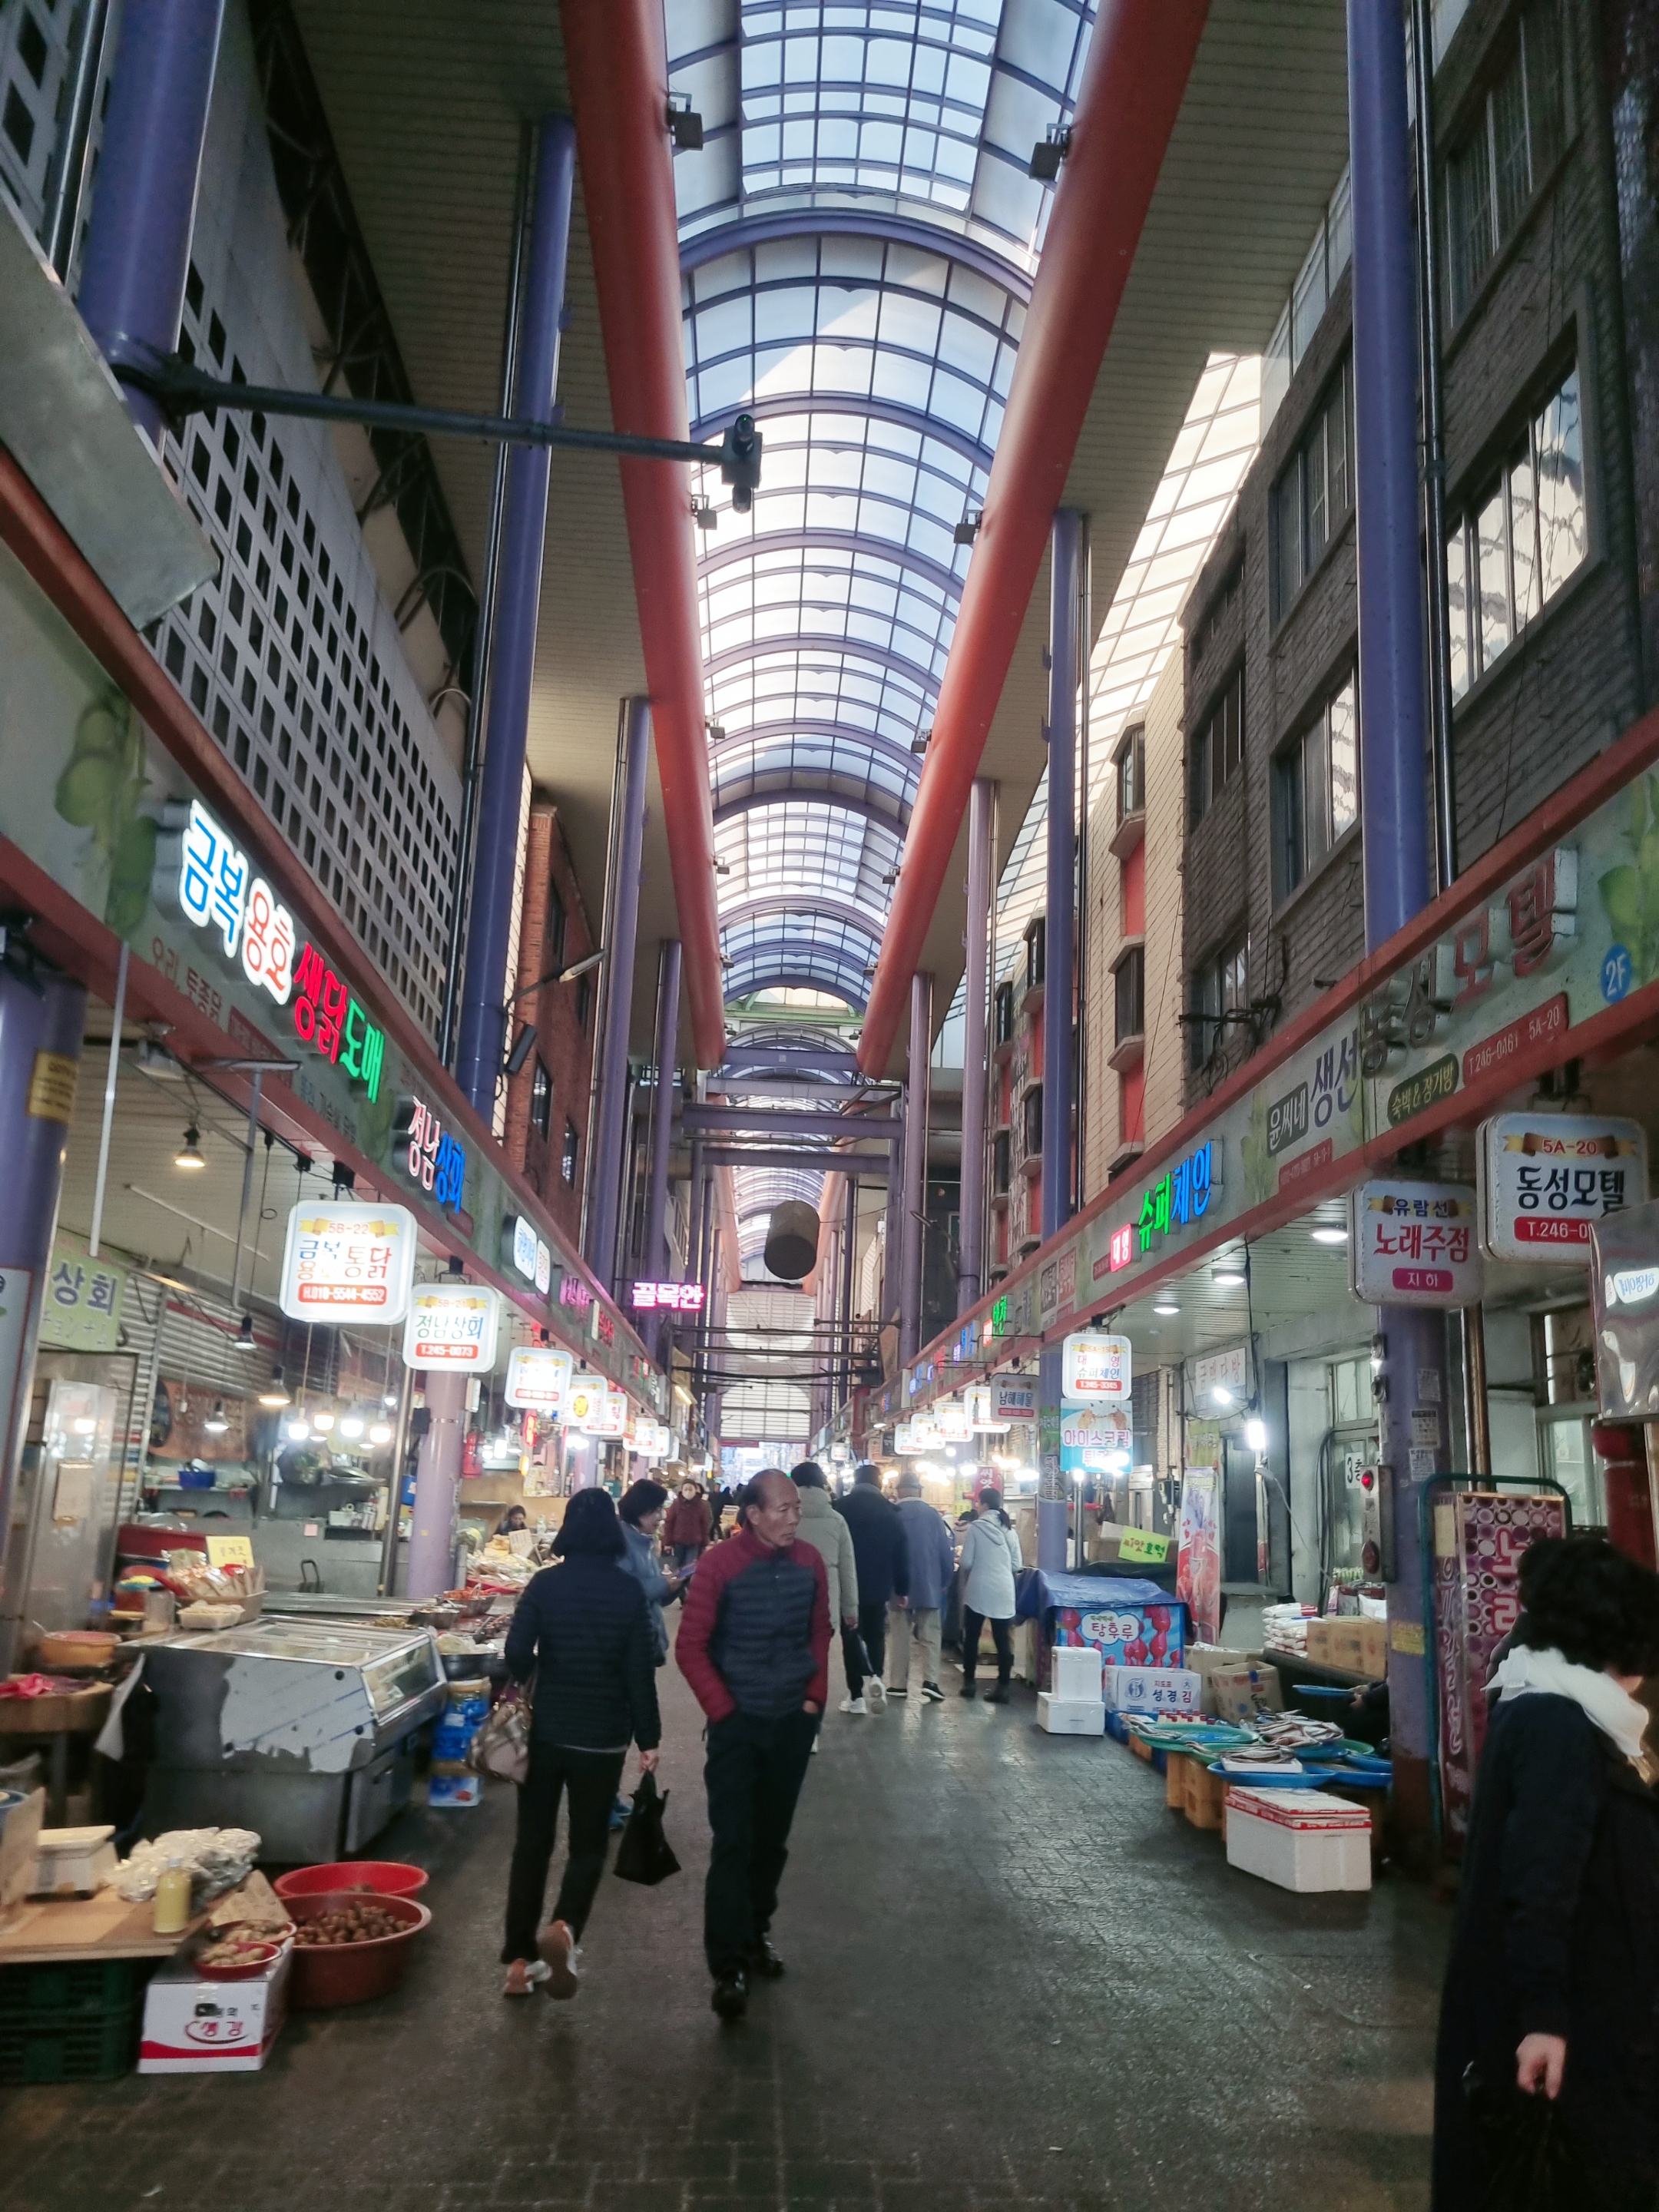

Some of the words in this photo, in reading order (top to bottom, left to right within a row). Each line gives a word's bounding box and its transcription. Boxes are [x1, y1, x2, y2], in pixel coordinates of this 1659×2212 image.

[185, 817, 243, 943] 금복
[247, 891, 291, 992] 용호
[293, 941, 347, 1065] 생닭
[339, 998, 384, 1104] 도매
[1606, 953, 1626, 997] 2F
[1529, 1005, 1559, 1041] 5A-20
[1270, 1087, 1306, 1151] 윤씨네
[1311, 1028, 1358, 1128] 생선
[1542, 1139, 1597, 1154] 5A-20
[1113, 1229, 1130, 1264] 대영
[1139, 1141, 1211, 1253] 슈퍼체인
[1516, 1166, 1625, 1213] 동성모텔
[1394, 1199, 1448, 1218] 유람선
[329, 1223, 369, 1234] 5B-22
[1373, 1223, 1469, 1263] 노래주점
[300, 1240, 341, 1260] 금복
[345, 1246, 392, 1279] 통닭
[51, 1261, 117, 1317] 상회
[632, 1282, 706, 1311] 골목안
[416, 1315, 484, 1339] 정남상회
[1077, 1367, 1120, 1379] 슈퍼체인
[1064, 1429, 1130, 1447] 아이스크림
[1091, 1622, 1133, 1639] 탕후루
